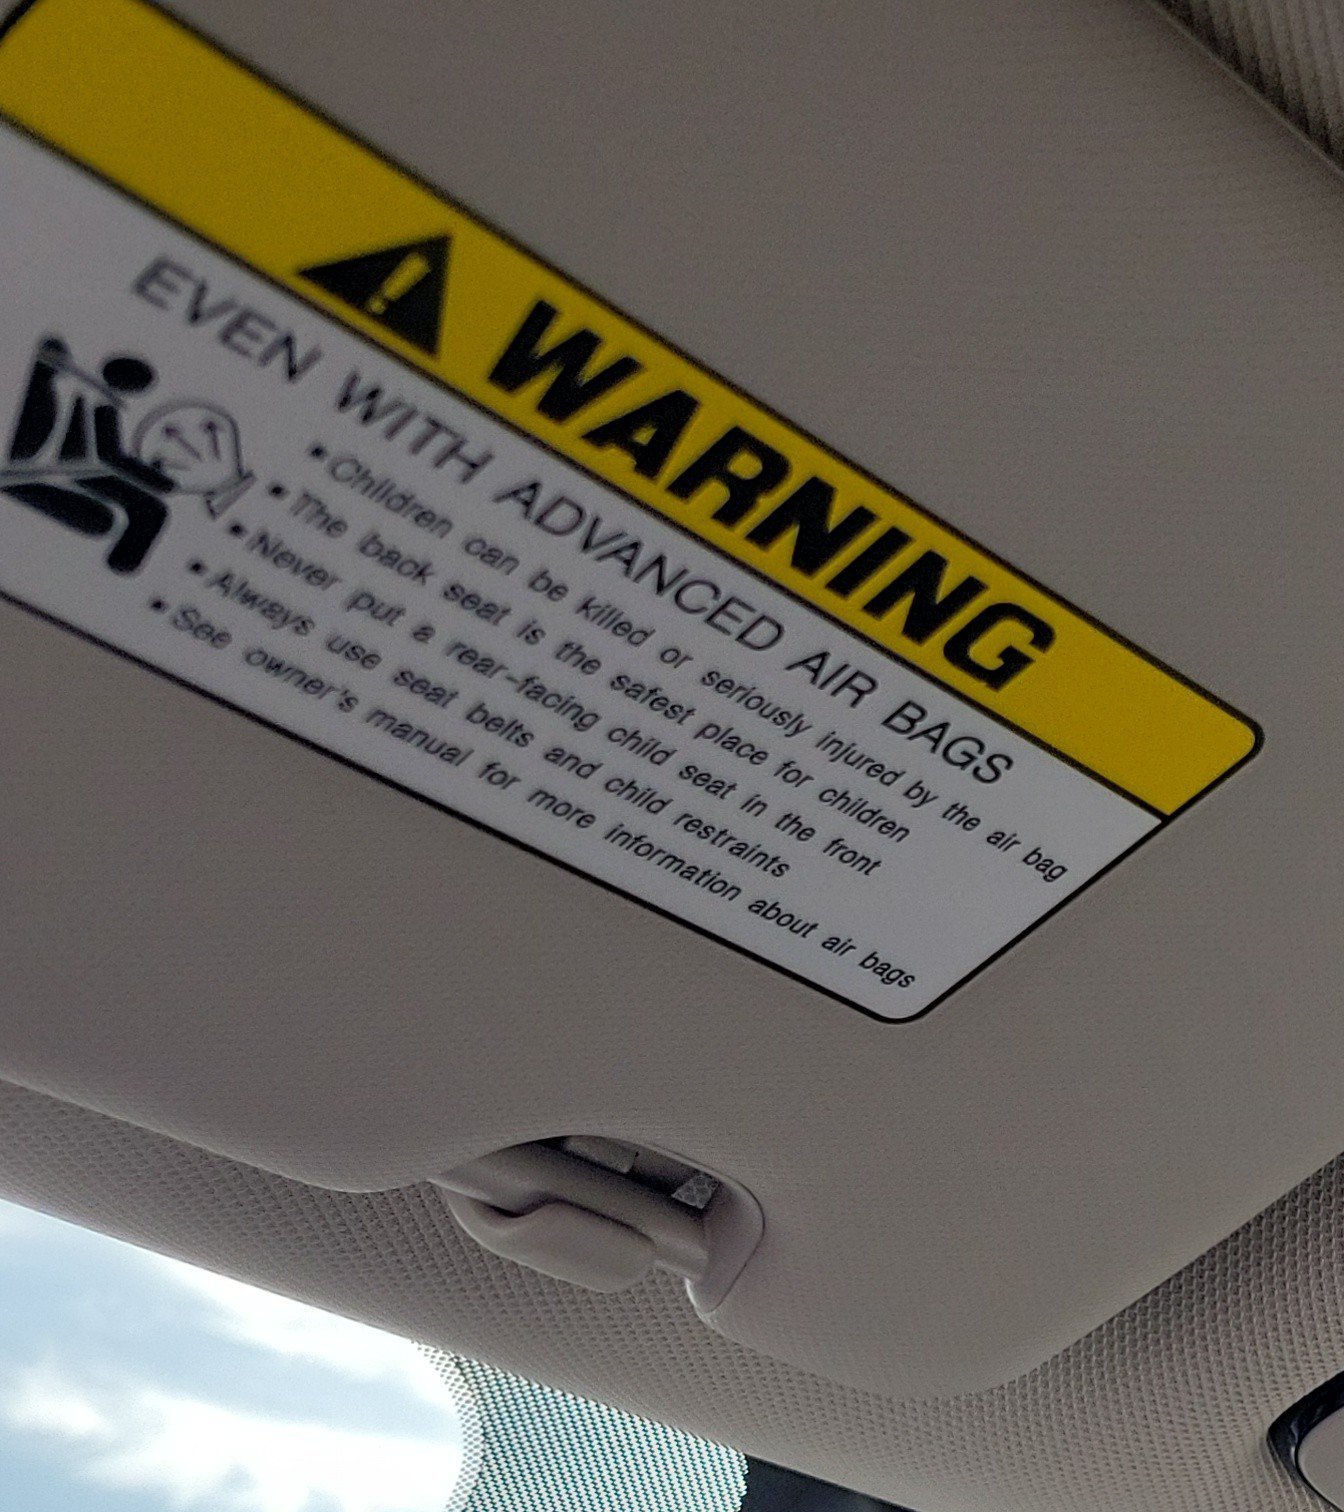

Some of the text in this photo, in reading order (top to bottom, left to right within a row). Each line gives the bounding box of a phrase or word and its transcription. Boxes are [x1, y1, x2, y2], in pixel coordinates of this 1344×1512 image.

[132, 254, 1013, 784] EVEN WITH ADVANCED AIR BAGS
[290, 492, 910, 843] The back seat is the safest place for children
[328, 455, 1068, 883] Children can be killed or seriously injured by the air bag
[488, 298, 1056, 692] WARNING
[169, 606, 916, 990] See owner's manual for more information about air bags
[204, 570, 791, 878] Always use seat belts and child restraints
[247, 529, 882, 876] Never put a rear-facing child seat in the front
